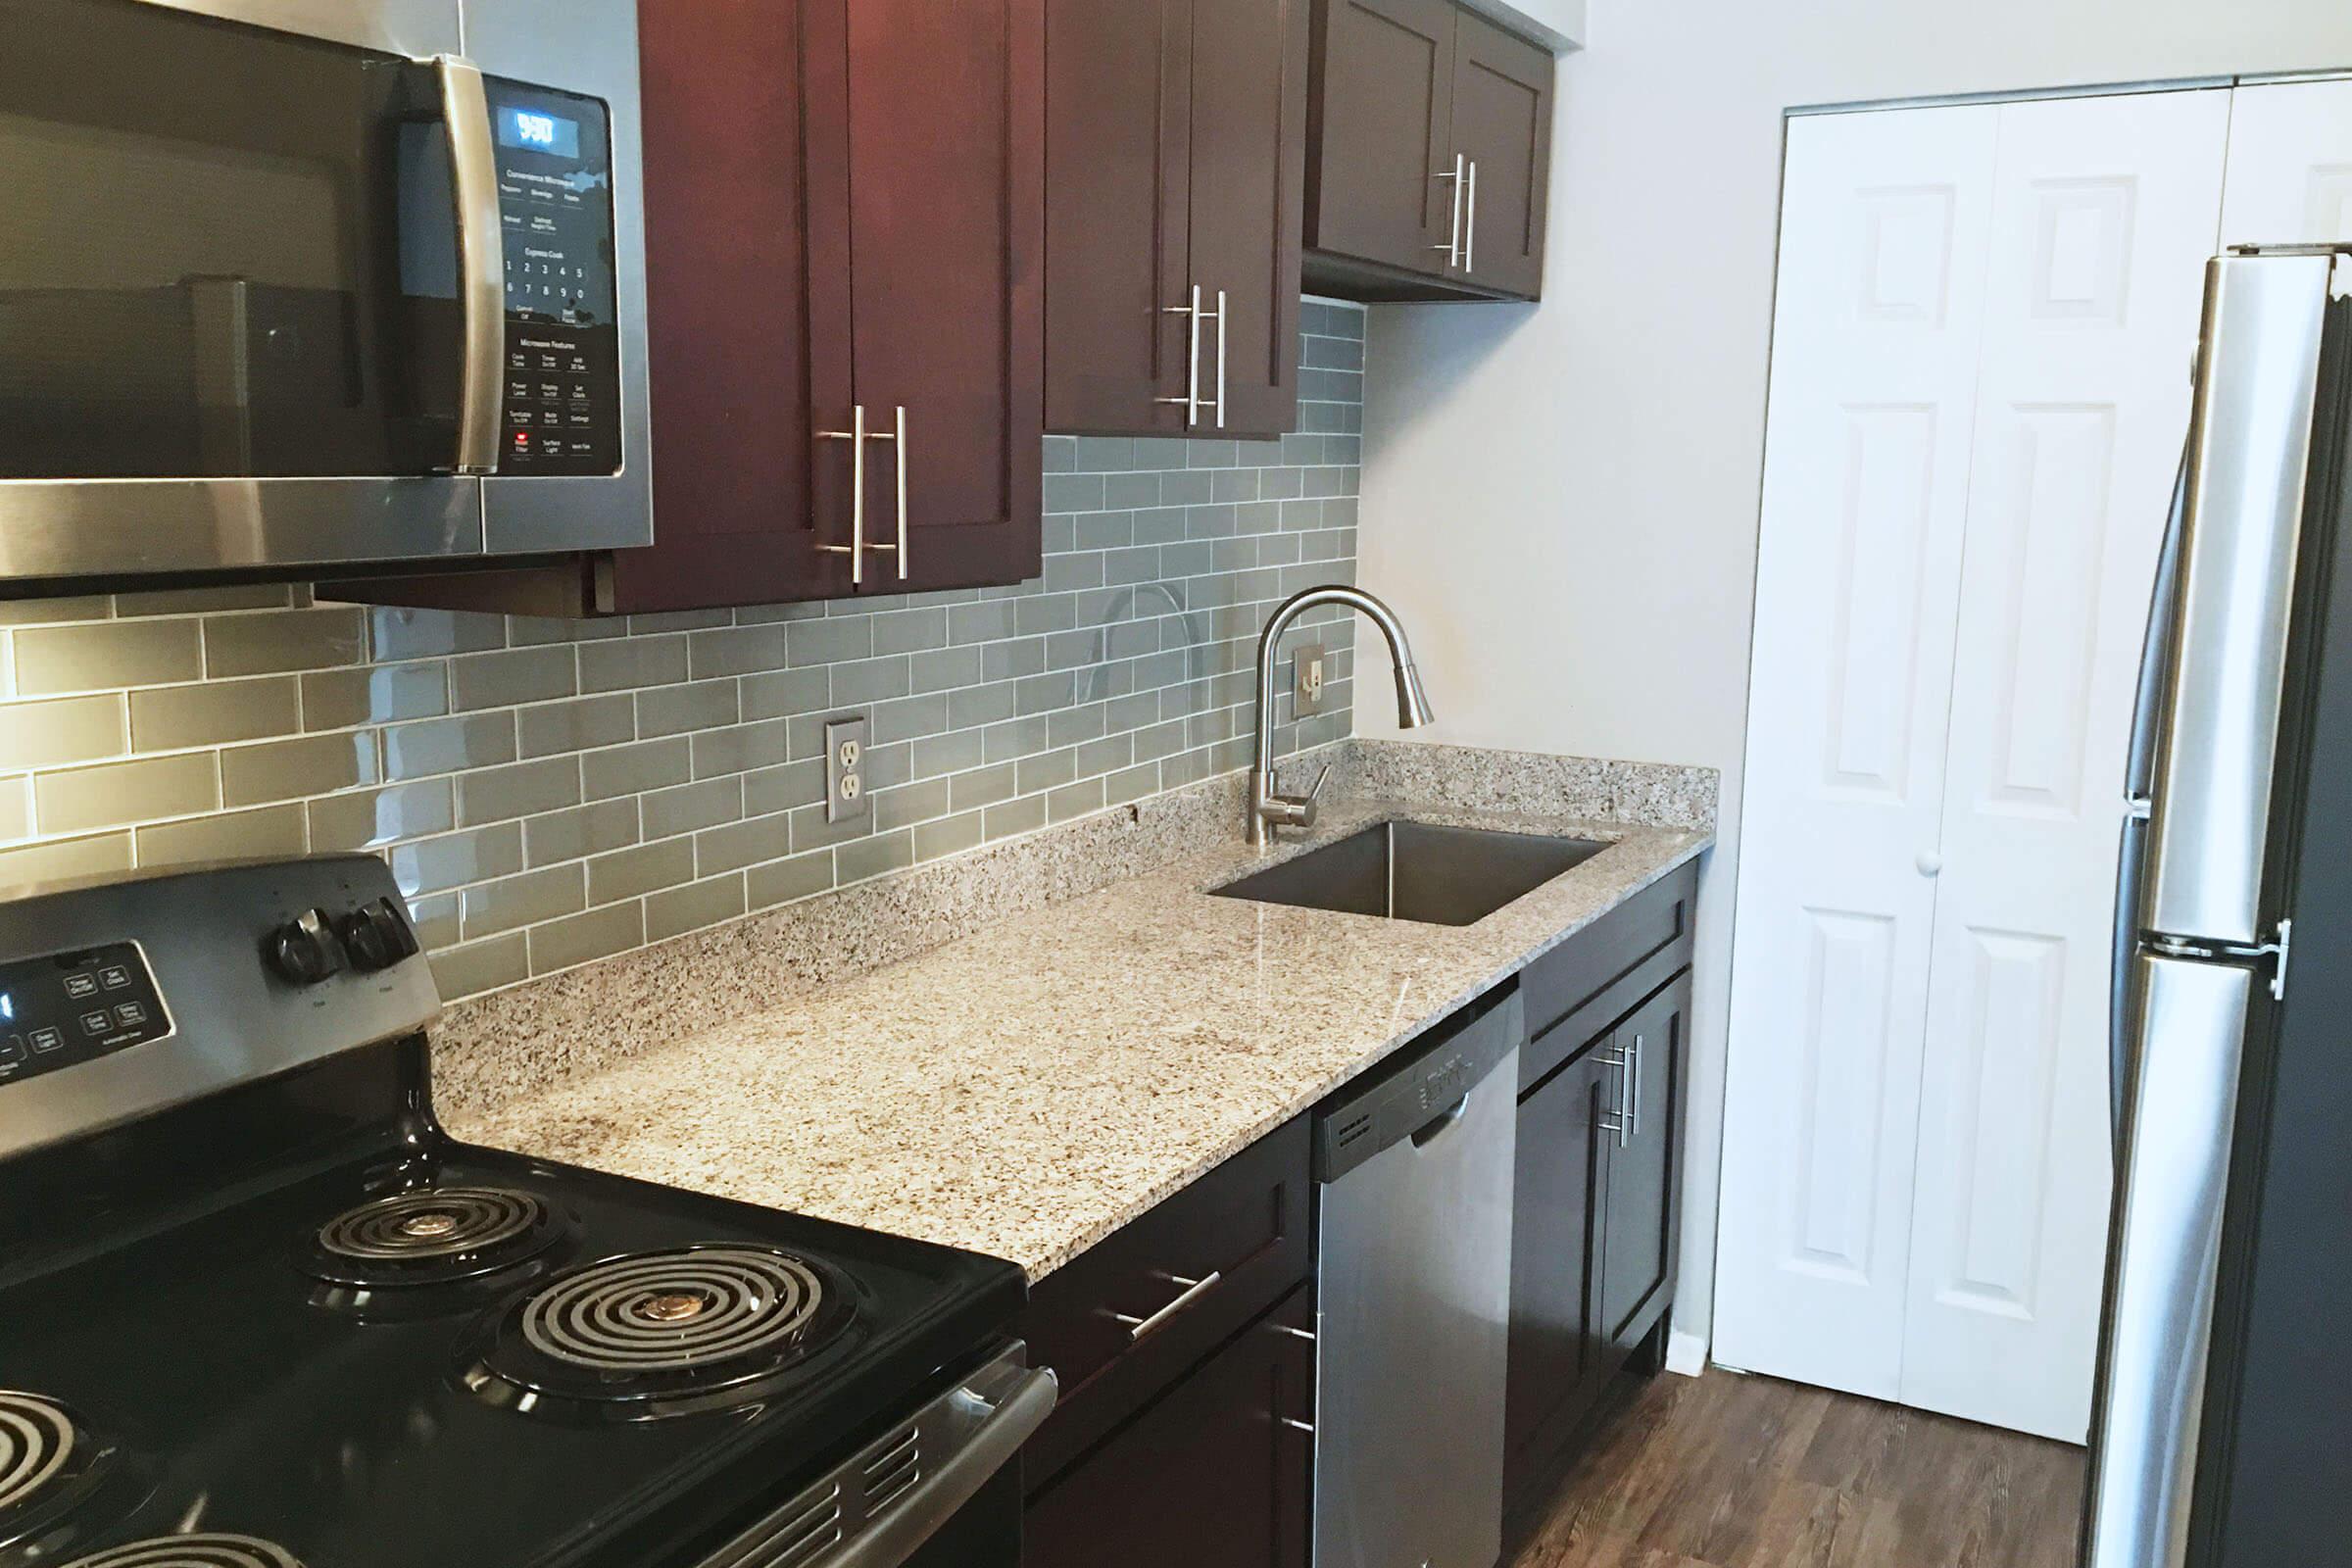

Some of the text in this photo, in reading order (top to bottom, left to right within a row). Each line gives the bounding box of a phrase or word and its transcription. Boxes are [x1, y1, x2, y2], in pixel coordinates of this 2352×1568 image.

[506, 169, 575, 187] Convenience Microwave
[524, 247, 564, 259] Express Cook
[506, 260, 582, 278] 1 2 3 4 5
[507, 281, 584, 299] 6 7 8 9 0
[519, 337, 576, 351] Microwave Features
